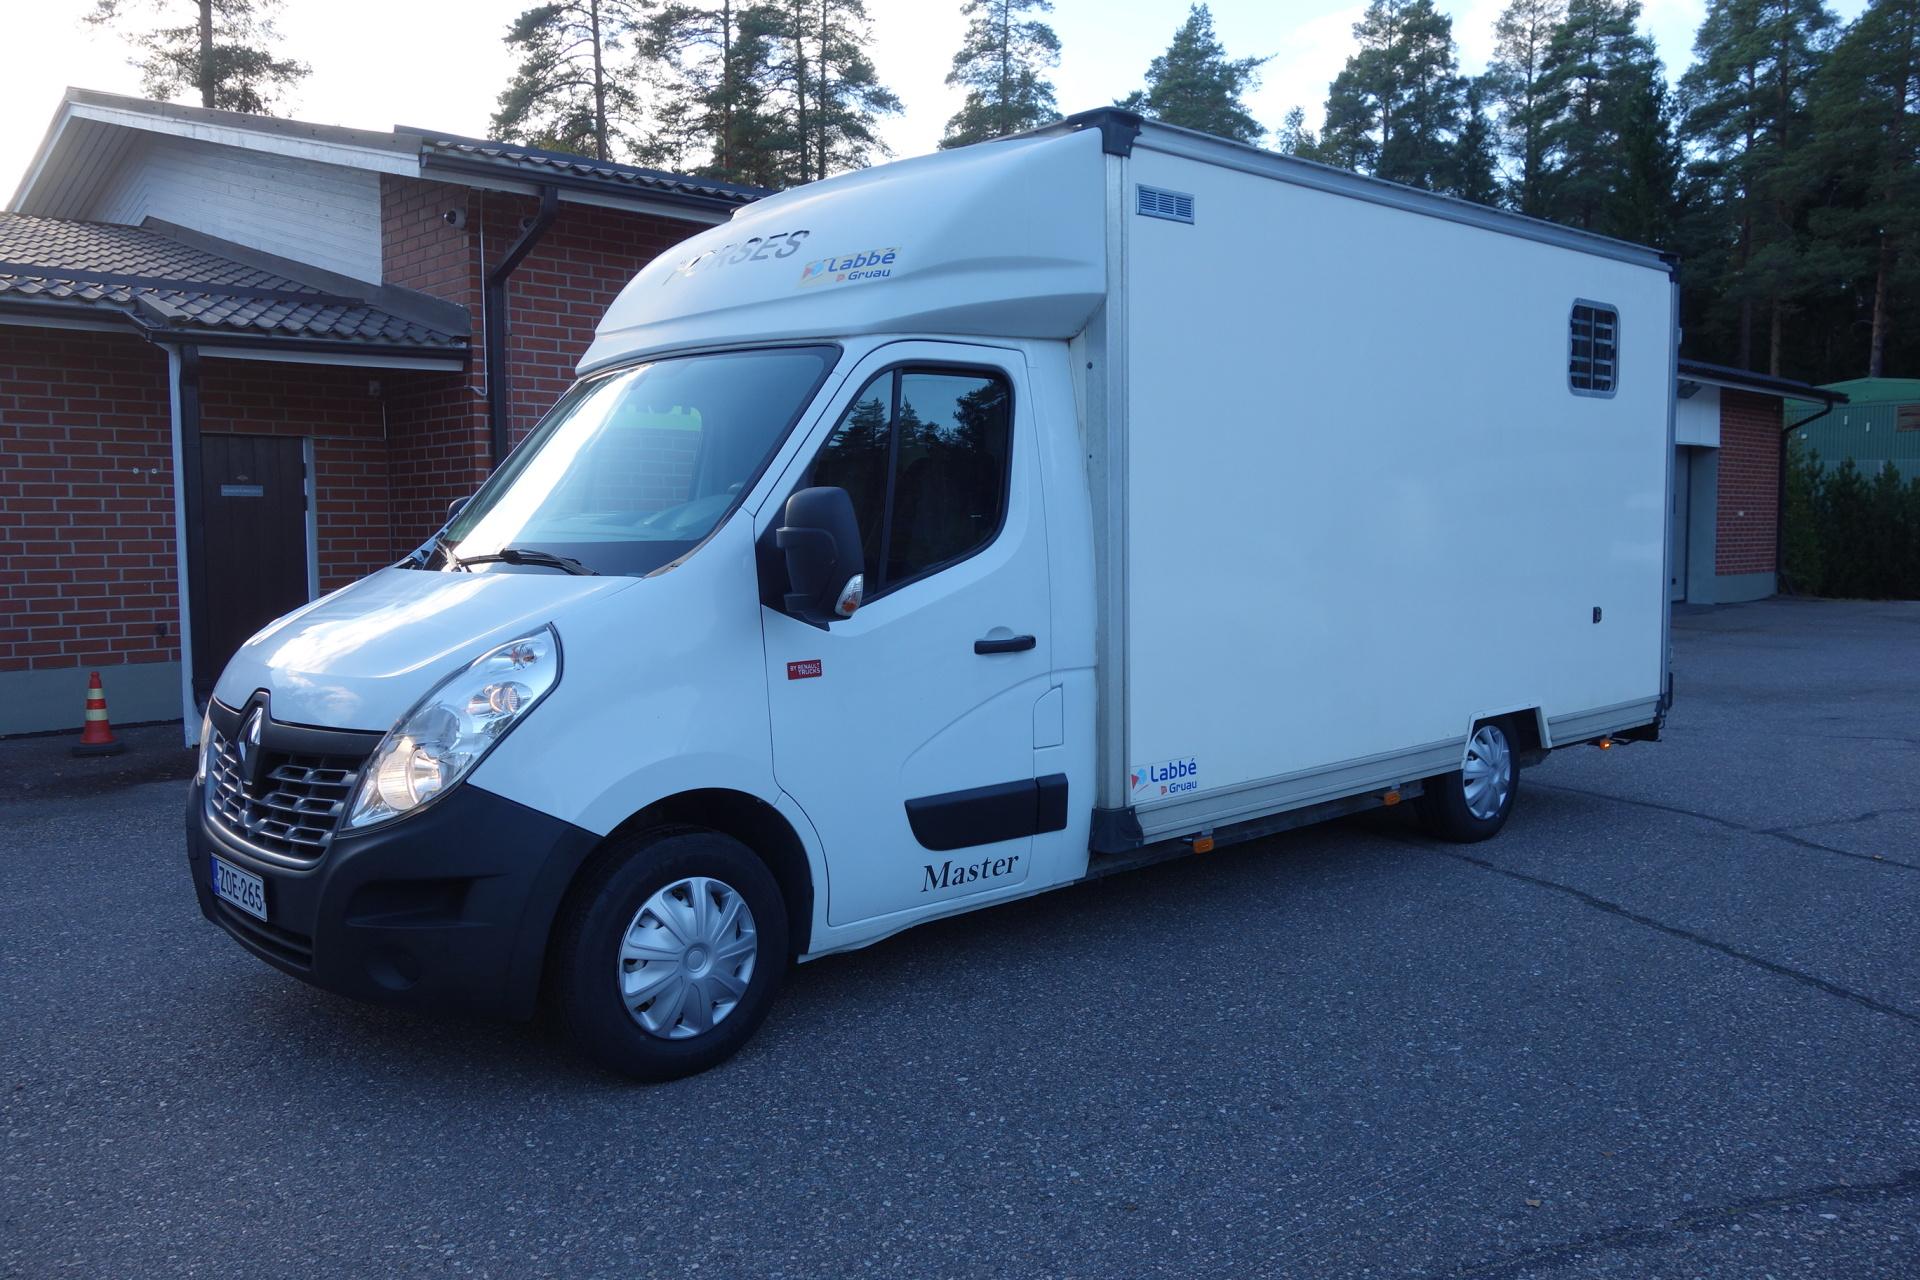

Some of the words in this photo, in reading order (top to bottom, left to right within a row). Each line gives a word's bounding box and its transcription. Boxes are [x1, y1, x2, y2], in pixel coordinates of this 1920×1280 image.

[662, 229, 811, 287] RSES
[828, 247, 897, 273] Labbé
[848, 267, 891, 281] Gruau
[798, 668, 821, 676] TRUCKS
[1150, 757, 1197, 783] Labbé
[1169, 780, 1198, 794] Gruau
[920, 855, 1020, 893] Master
[219, 865, 263, 912] ZOE-265
